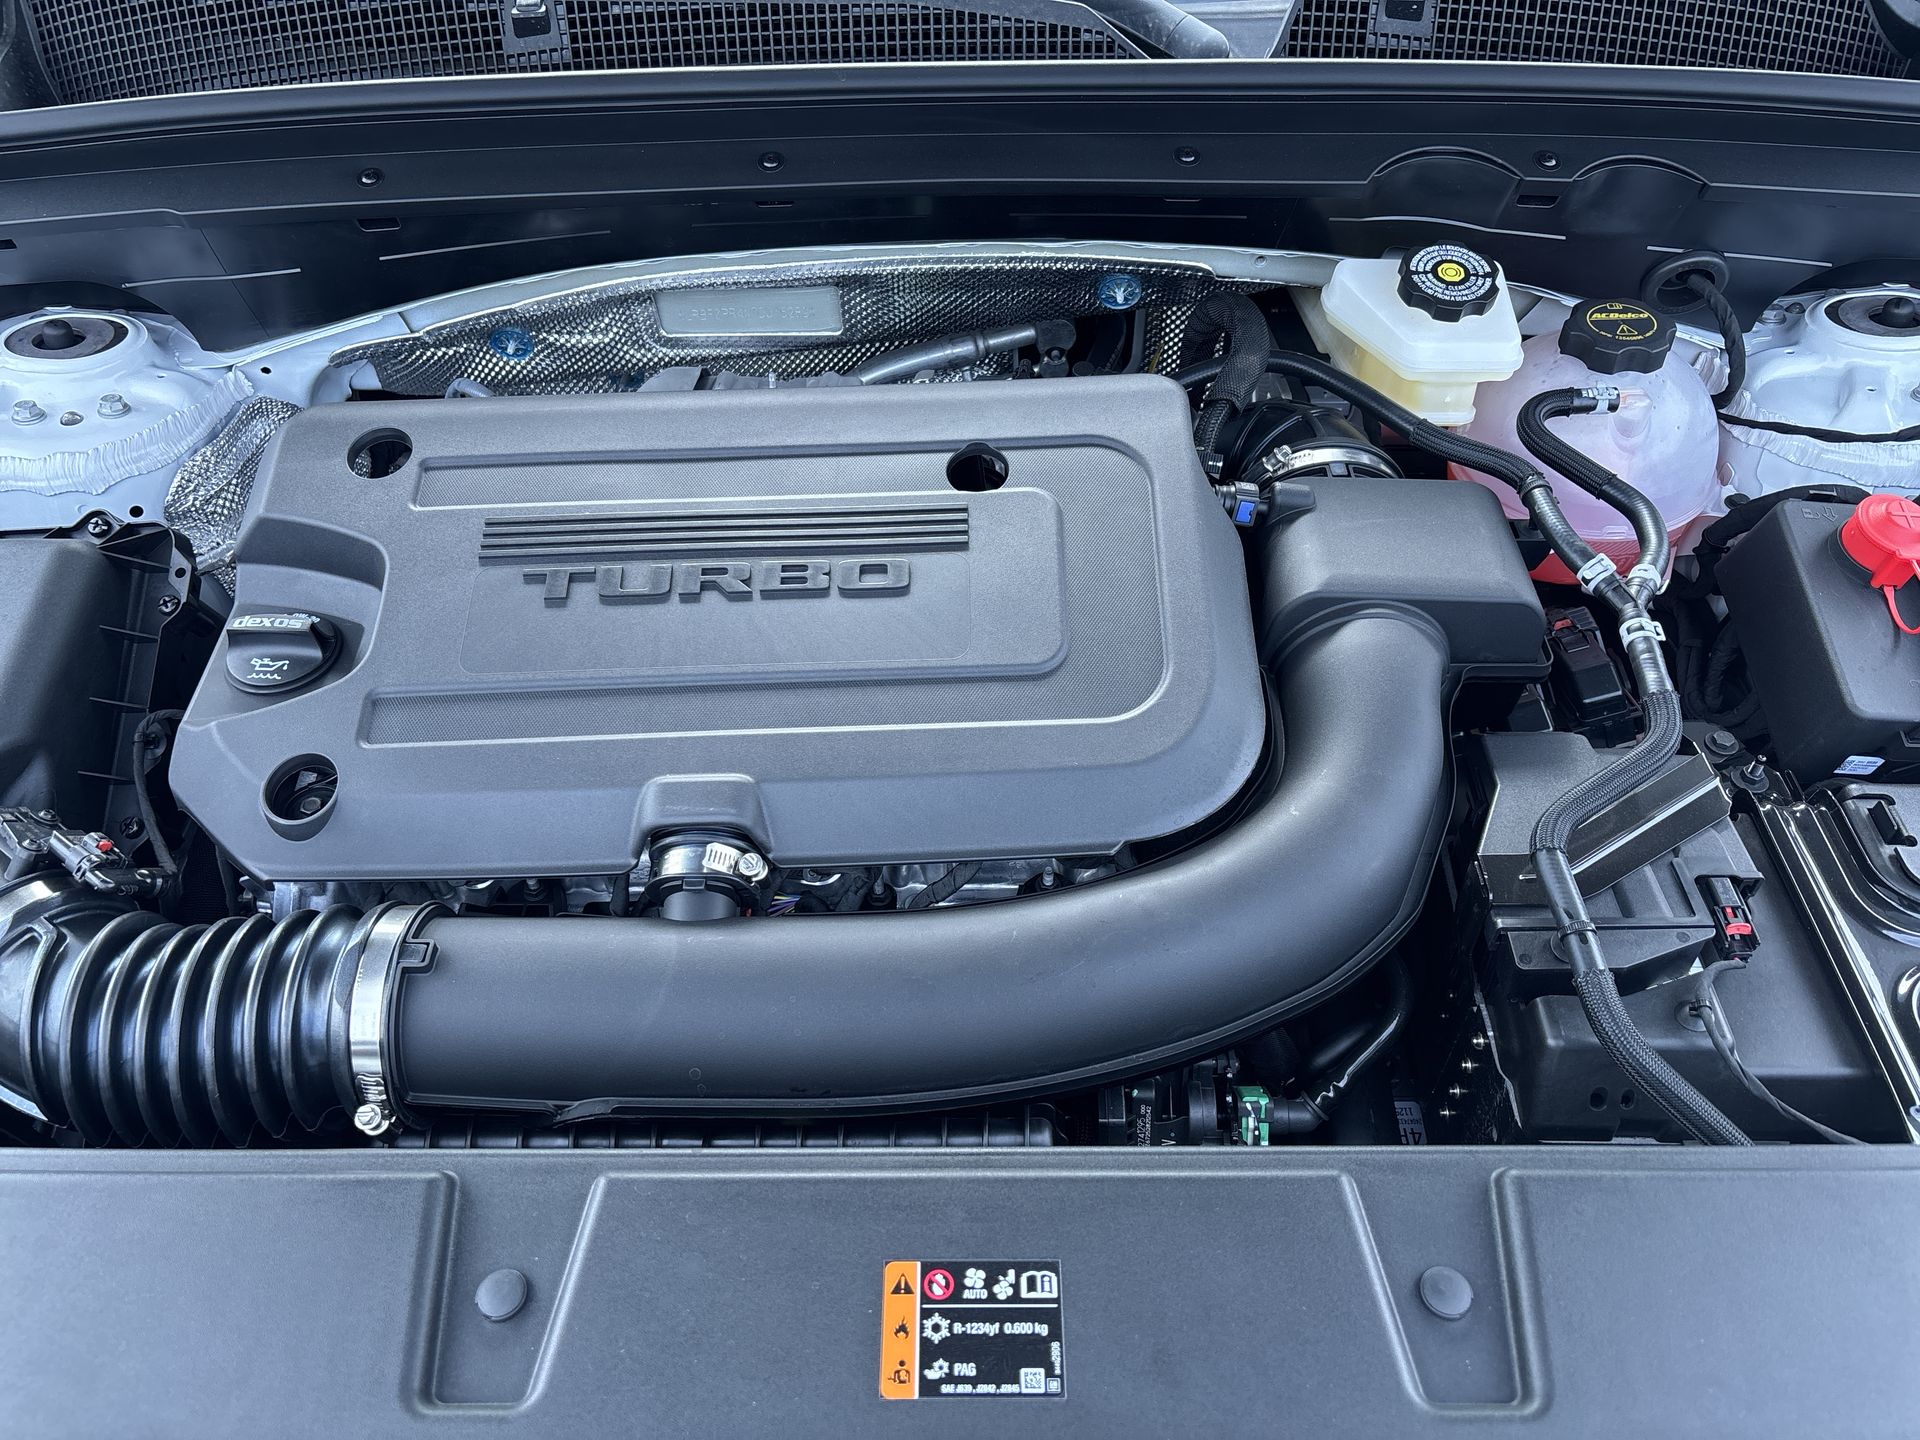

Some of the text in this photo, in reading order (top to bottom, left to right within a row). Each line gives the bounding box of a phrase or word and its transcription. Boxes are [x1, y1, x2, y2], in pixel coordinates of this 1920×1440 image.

[1590, 312, 1649, 320] ACDelco
[522, 558, 911, 606] TURBO
[233, 616, 302, 628] dexos
[962, 1288, 988, 1299] AUTO
[953, 1322, 1049, 1337] R-1234yf 0.600 kg
[953, 1362, 977, 1377] PAG
[941, 1384, 956, 1393] SAE
